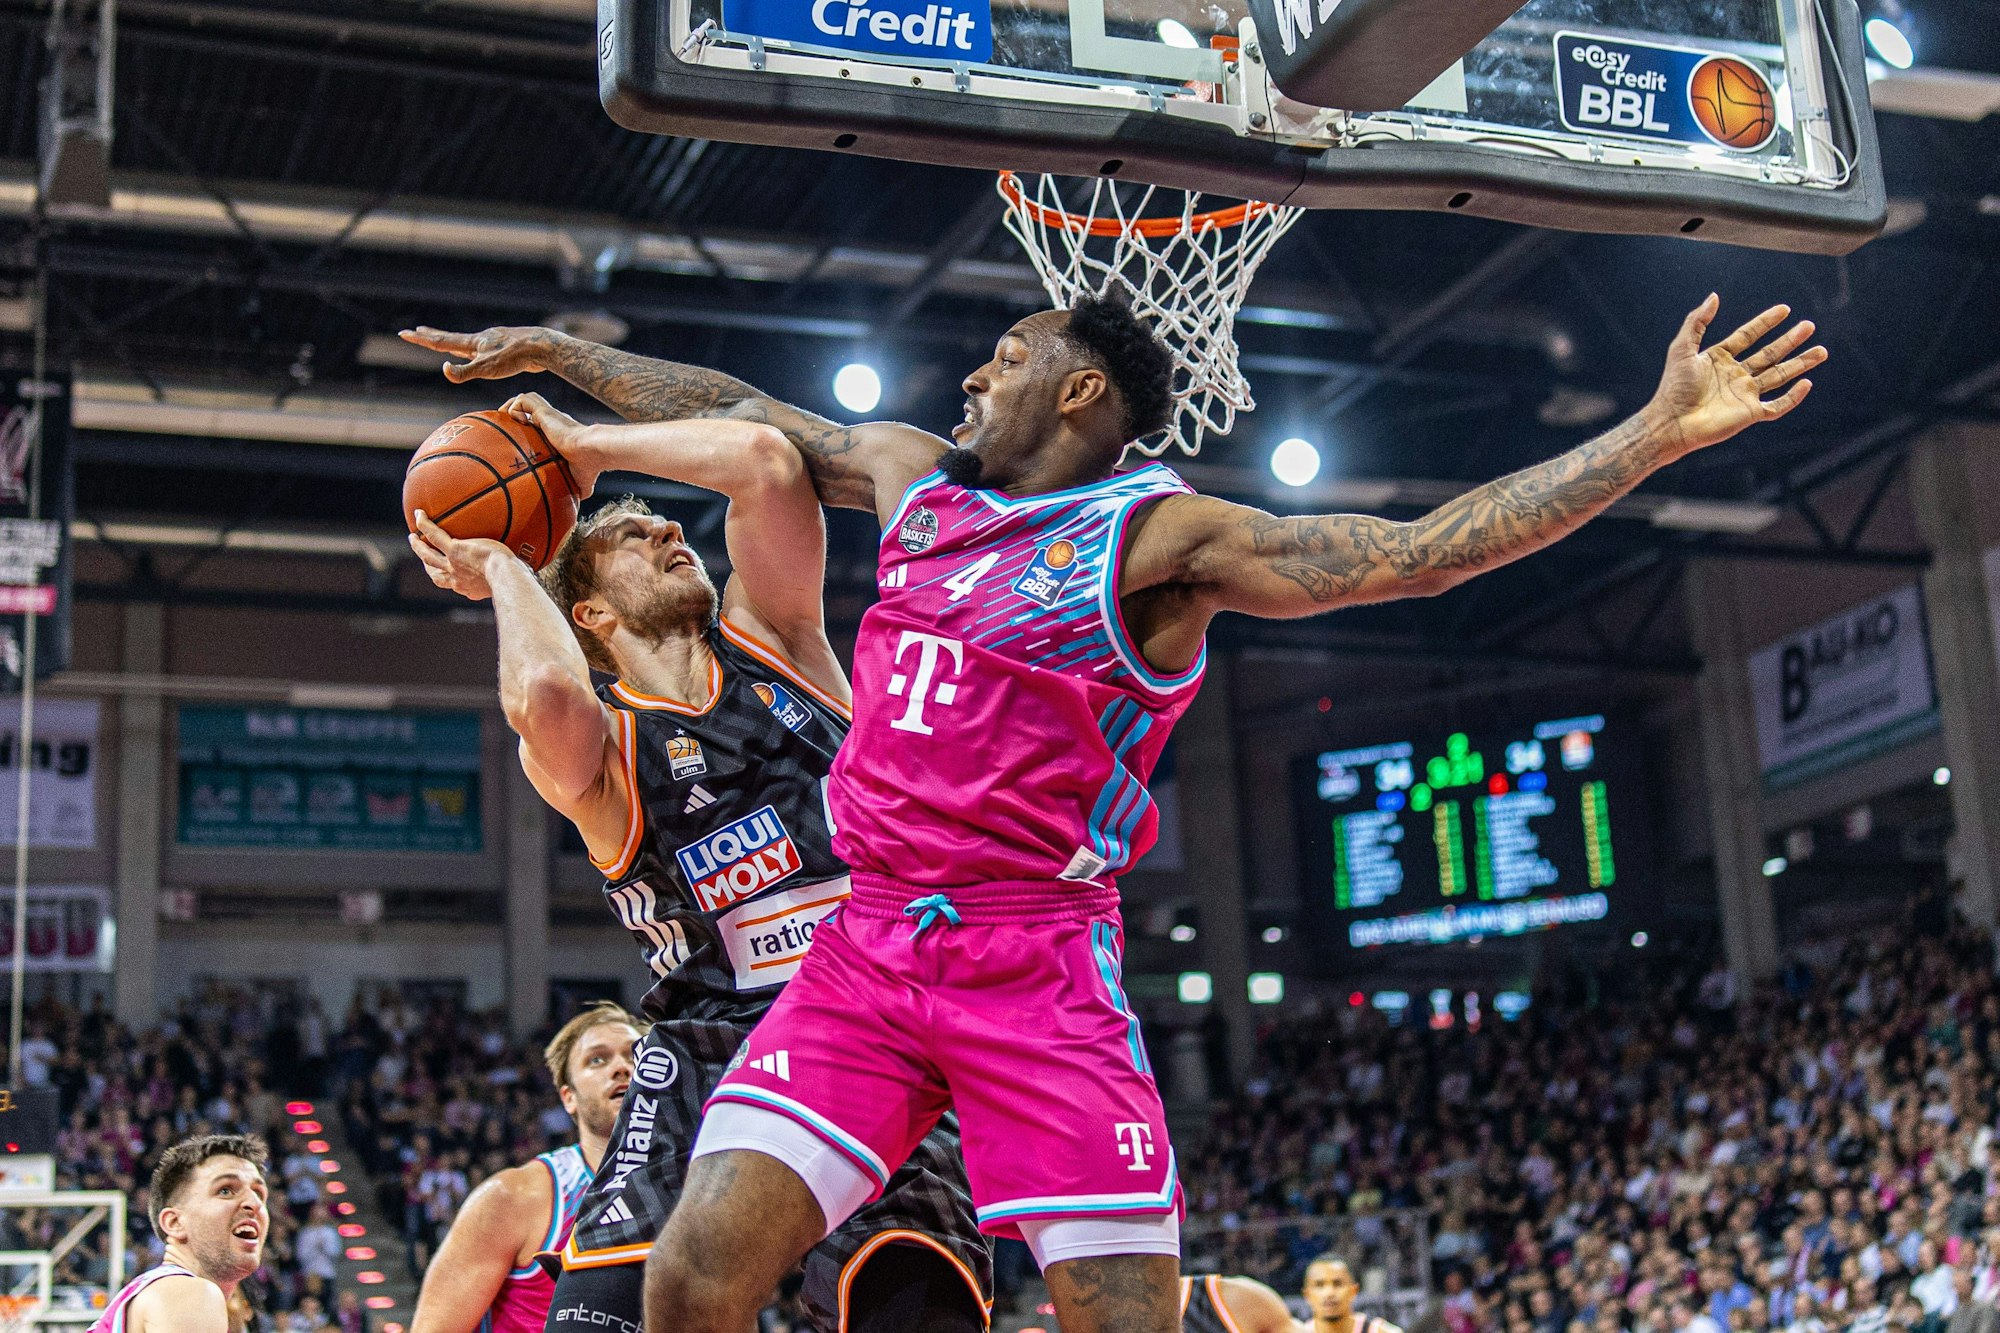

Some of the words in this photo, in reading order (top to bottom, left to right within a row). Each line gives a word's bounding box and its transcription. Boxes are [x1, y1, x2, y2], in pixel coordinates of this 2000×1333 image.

[811, 0, 975, 50] Credit
[1572, 45, 1631, 72] e@sy
[1601, 66, 1667, 92] Credit
[1578, 84, 1670, 132] BBL
[901, 527, 935, 546] BASKETS
[941, 551, 1002, 602] 4
[1018, 577, 1051, 601] BBL
[887, 630, 963, 736] T
[782, 710, 805, 729] BL
[680, 766, 698, 775] ulm
[683, 812, 780, 880] LIQUI
[698, 839, 791, 912] MOLY
[1115, 1123, 1155, 1171] T
